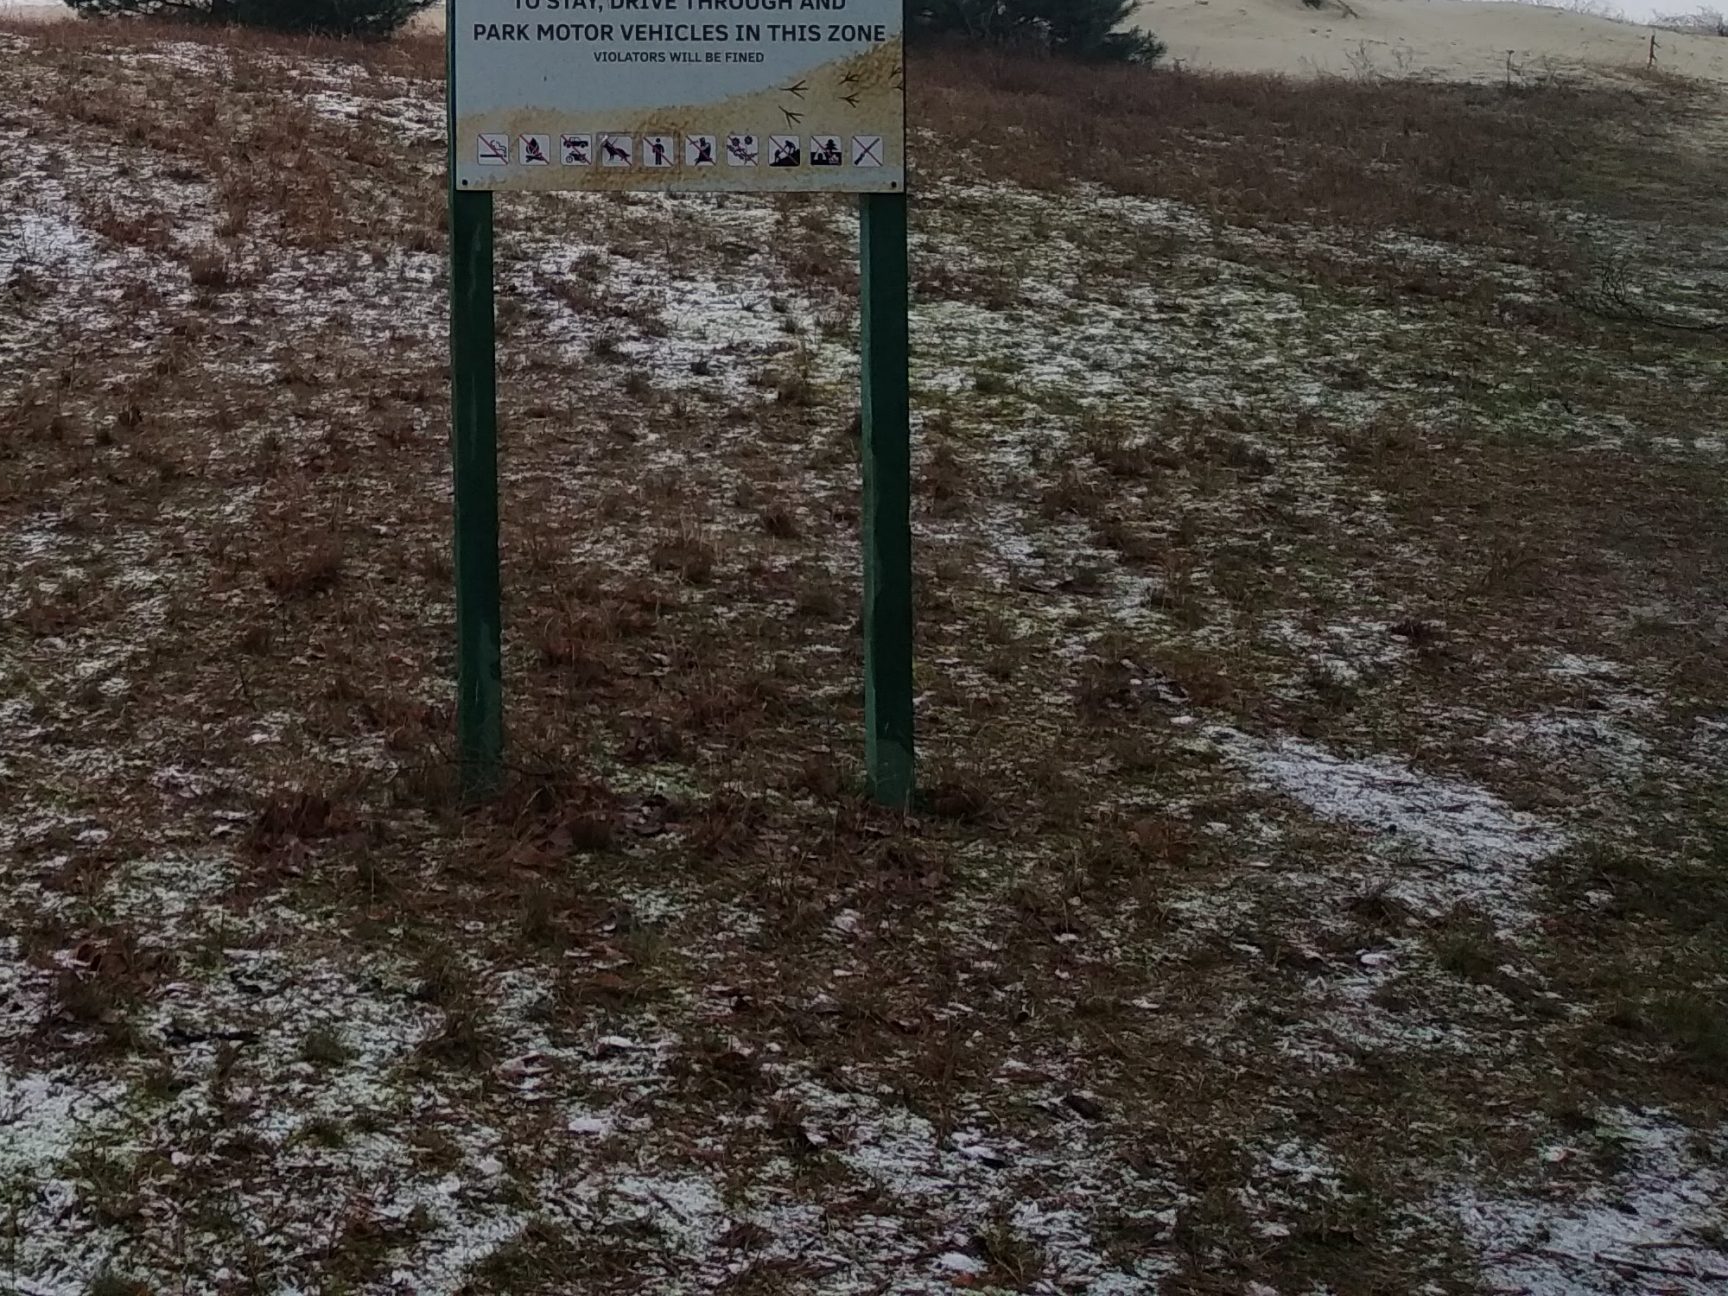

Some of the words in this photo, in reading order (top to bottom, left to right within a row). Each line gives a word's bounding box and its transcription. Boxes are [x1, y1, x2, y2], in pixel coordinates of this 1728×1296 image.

[474, 24, 530, 40] PARK
[537, 24, 613, 41] MOTOR
[620, 24, 728, 41] VEHICLES
[736, 25, 760, 41] IN
[767, 25, 821, 41] THIS
[828, 25, 886, 41] ZONE
[594, 52, 665, 62] VIOLATORS
[670, 52, 702, 62] WILL
[706, 52, 721, 62] BE
[725, 52, 764, 62] FINED
